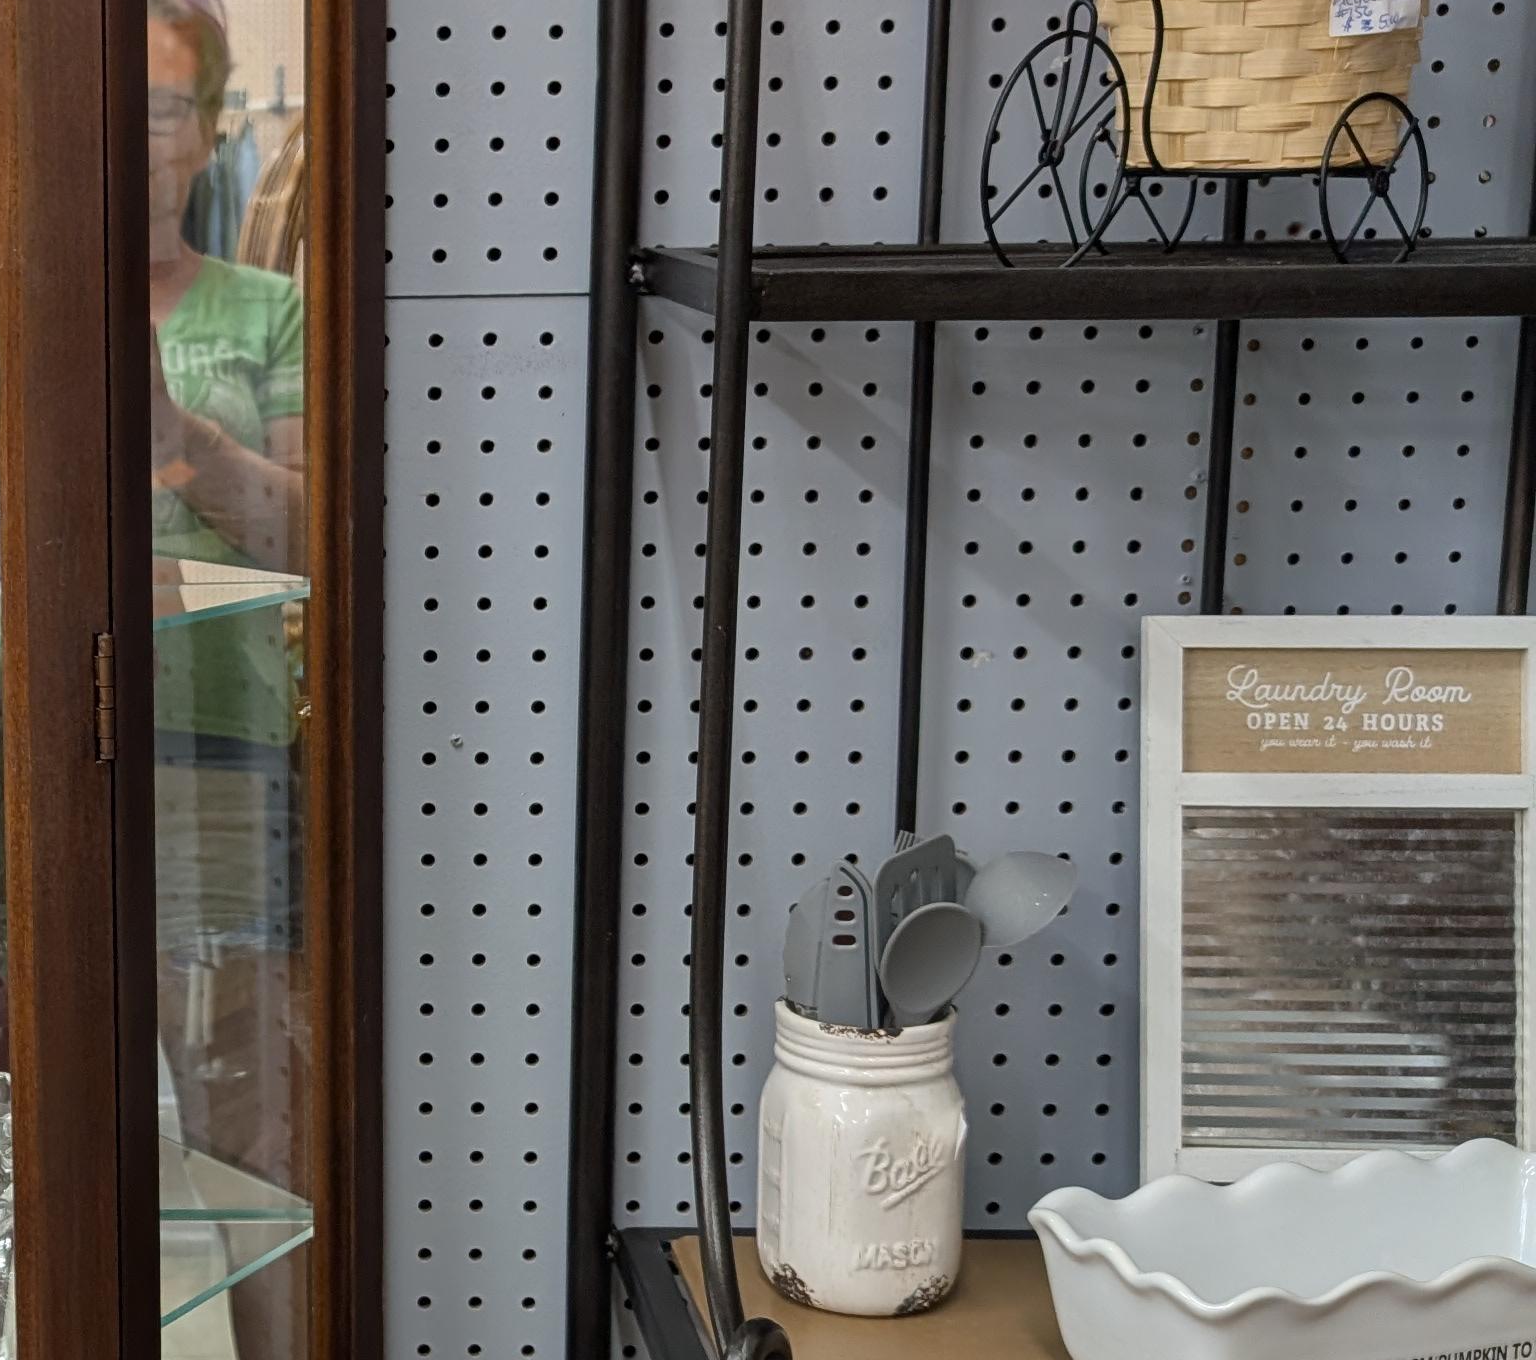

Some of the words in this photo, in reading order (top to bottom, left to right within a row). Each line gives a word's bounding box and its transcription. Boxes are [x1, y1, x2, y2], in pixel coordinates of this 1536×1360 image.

[1226, 665, 1367, 714] Laundry
[1382, 666, 1472, 705] Room
[1247, 712, 1310, 731] OPEN
[1323, 715, 1348, 732] 24
[1363, 713, 1445, 732] HOURS
[1259, 737, 1285, 752] you
[1288, 737, 1320, 748] wear
[1324, 734, 1337, 748] it
[1352, 737, 1379, 752] you
[1381, 735, 1416, 748] wash
[1419, 735, 1432, 748] it
[855, 1239, 935, 1271] MASON
[1512, 1341, 1533, 1360] TO
